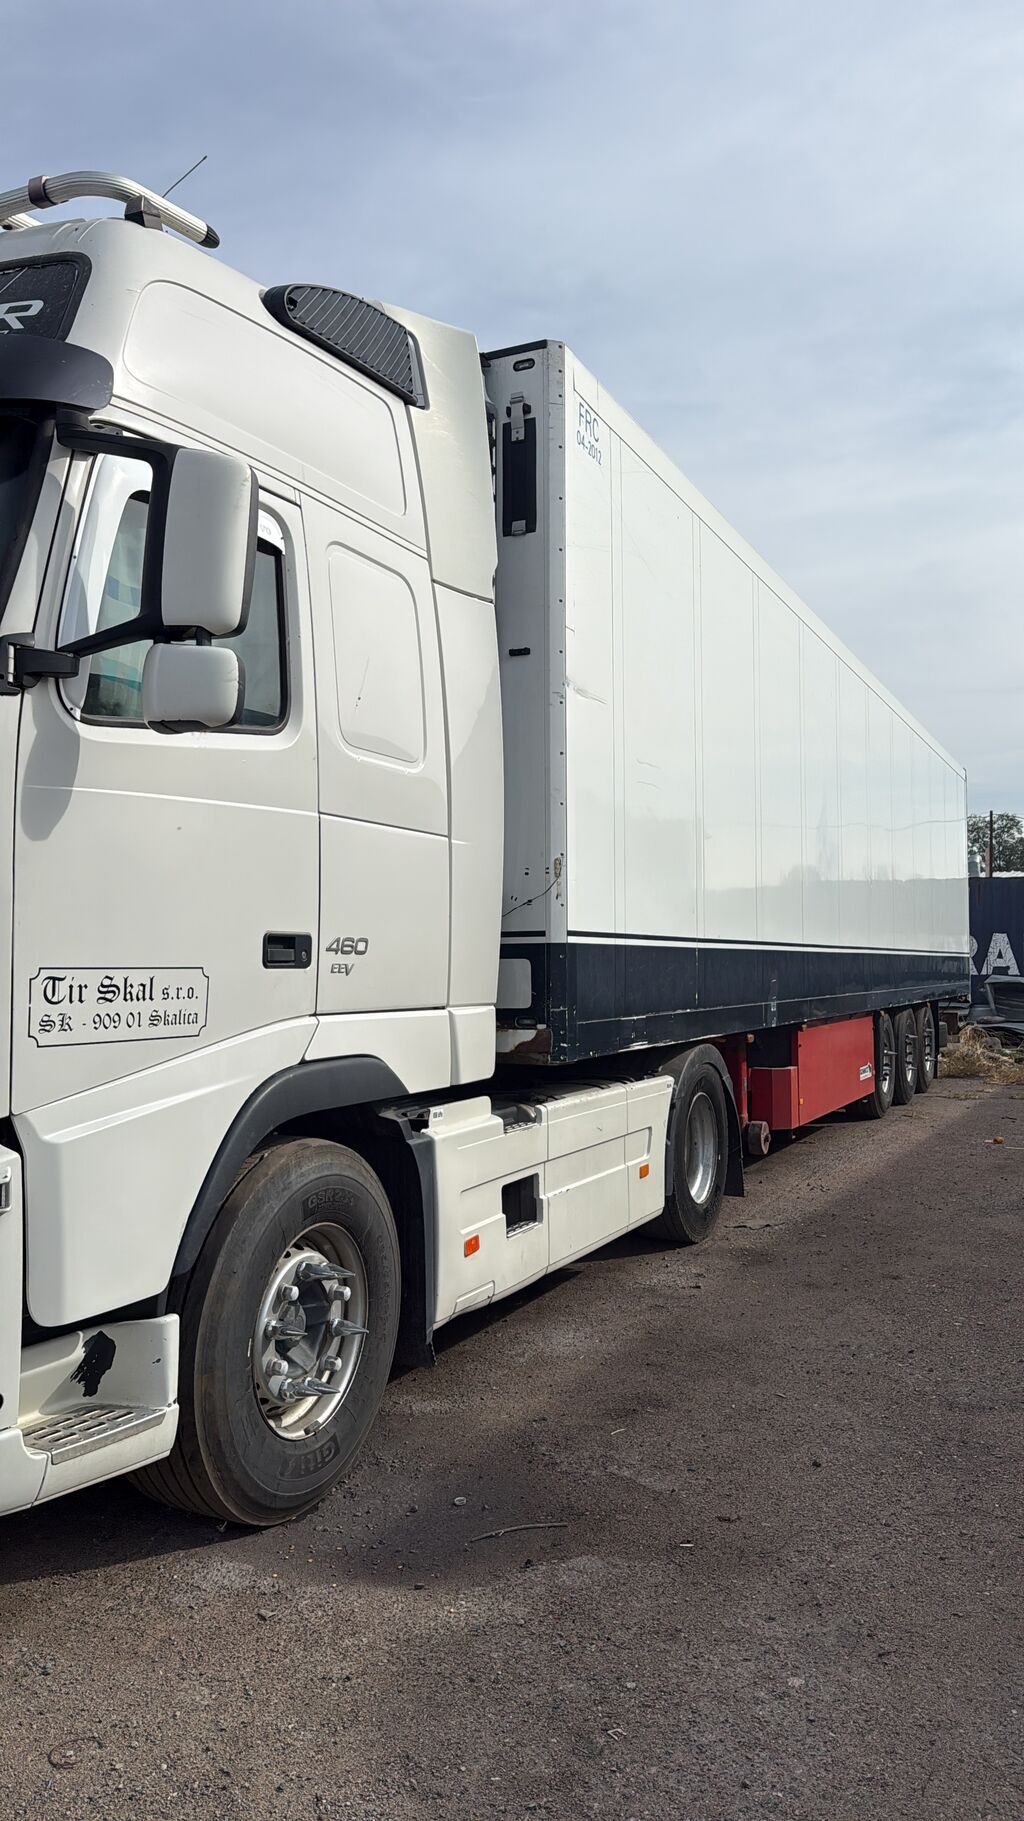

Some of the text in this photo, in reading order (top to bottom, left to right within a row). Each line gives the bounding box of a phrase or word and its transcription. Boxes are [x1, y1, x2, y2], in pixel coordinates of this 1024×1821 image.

[578, 401, 600, 443] FRC
[576, 429, 602, 466] 04-2012
[325, 936, 369, 956] 460
[969, 932, 1021, 976] A
[330, 963, 355, 977] EEV
[41, 974, 199, 1006] Tir Skal s.r.o.
[38, 1012, 74, 1034] SK
[92, 1012, 121, 1031] 909
[125, 1011, 142, 1028] 01
[148, 1009, 199, 1028] Skalica
